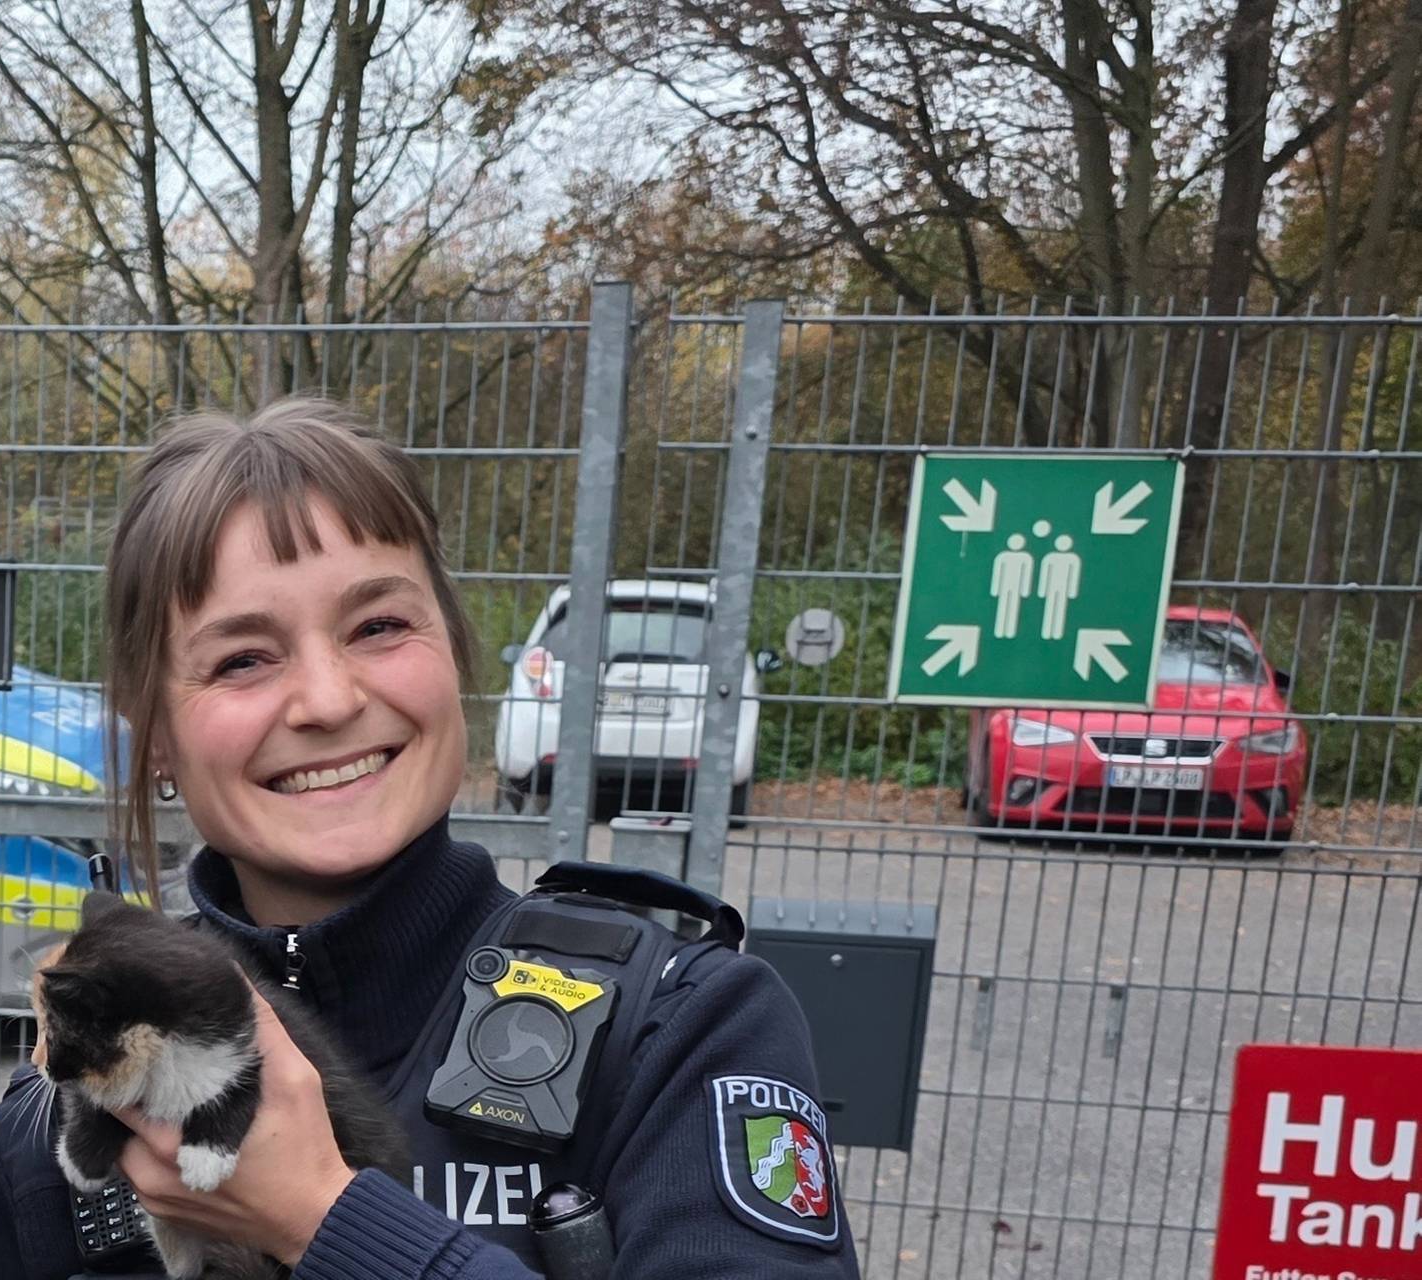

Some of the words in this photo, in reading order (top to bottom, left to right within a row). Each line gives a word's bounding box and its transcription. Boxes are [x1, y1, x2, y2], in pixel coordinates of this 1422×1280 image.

[542, 976, 577, 990] VIDEO
[539, 984, 547, 992] &
[550, 985, 586, 1000] AUDIO
[485, 1106, 525, 1124] AXON
[1259, 1092, 1418, 1181] Hu
